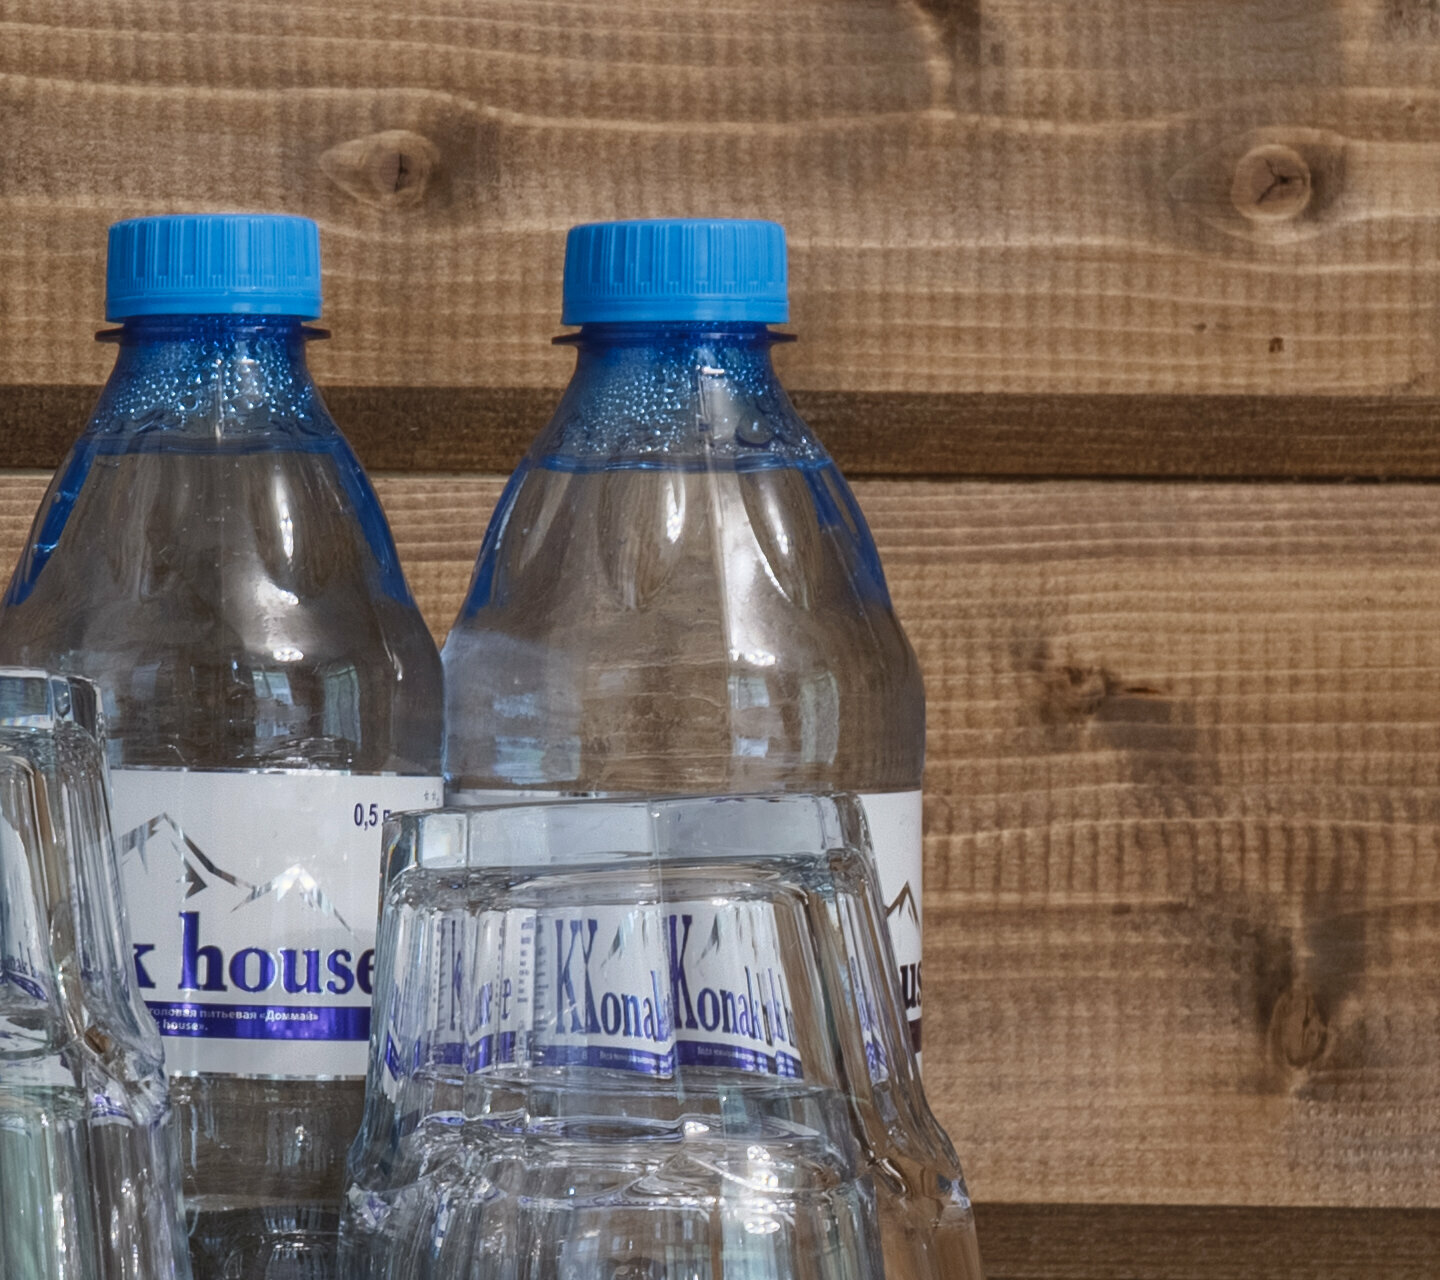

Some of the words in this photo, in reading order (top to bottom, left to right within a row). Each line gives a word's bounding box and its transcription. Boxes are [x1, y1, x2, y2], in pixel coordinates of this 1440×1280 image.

[353, 803, 378, 831] 0,5
[178, 911, 375, 995] house
[200, 1009, 257, 1020] питьевая
